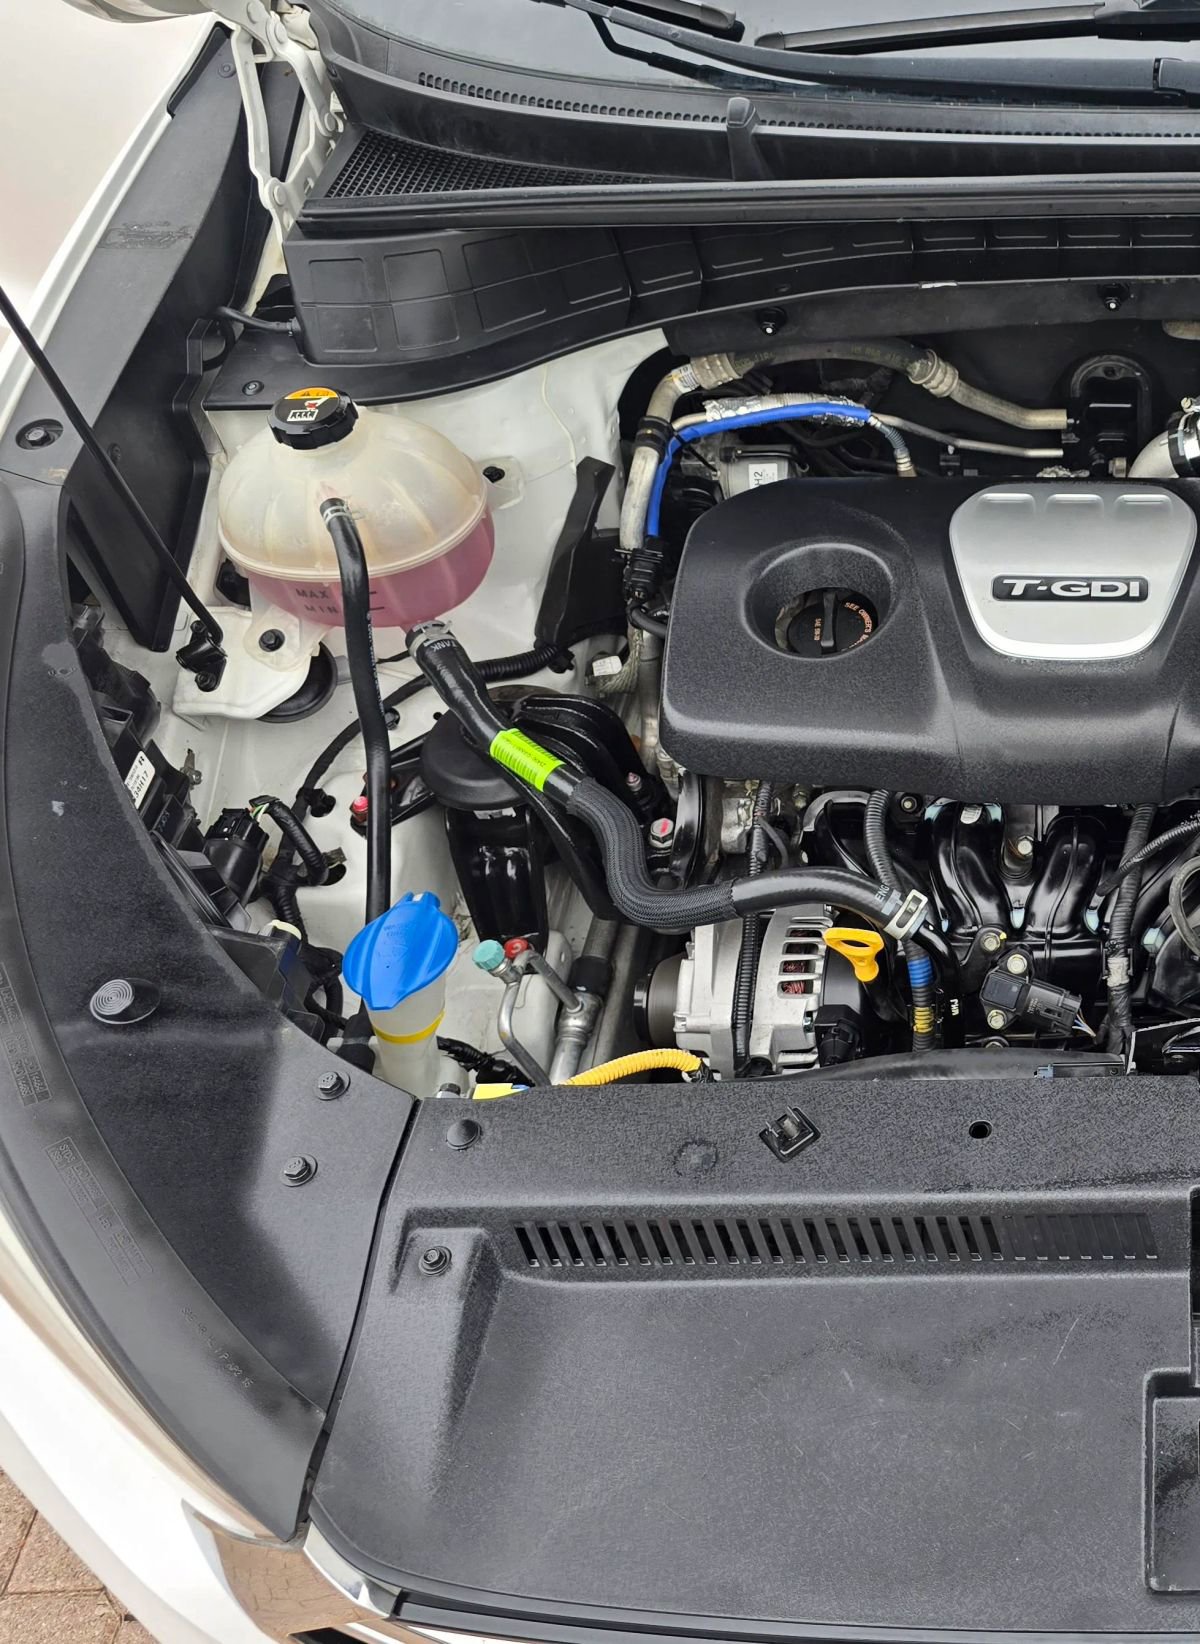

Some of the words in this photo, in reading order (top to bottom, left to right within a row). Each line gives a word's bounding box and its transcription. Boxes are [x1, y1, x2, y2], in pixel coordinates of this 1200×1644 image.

[295, 588, 329, 600] MAX
[1002, 579, 1140, 598] T-GDI
[303, 604, 339, 615] MIN
[430, 639, 457, 653] TANK
[874, 883, 891, 902] ENG
